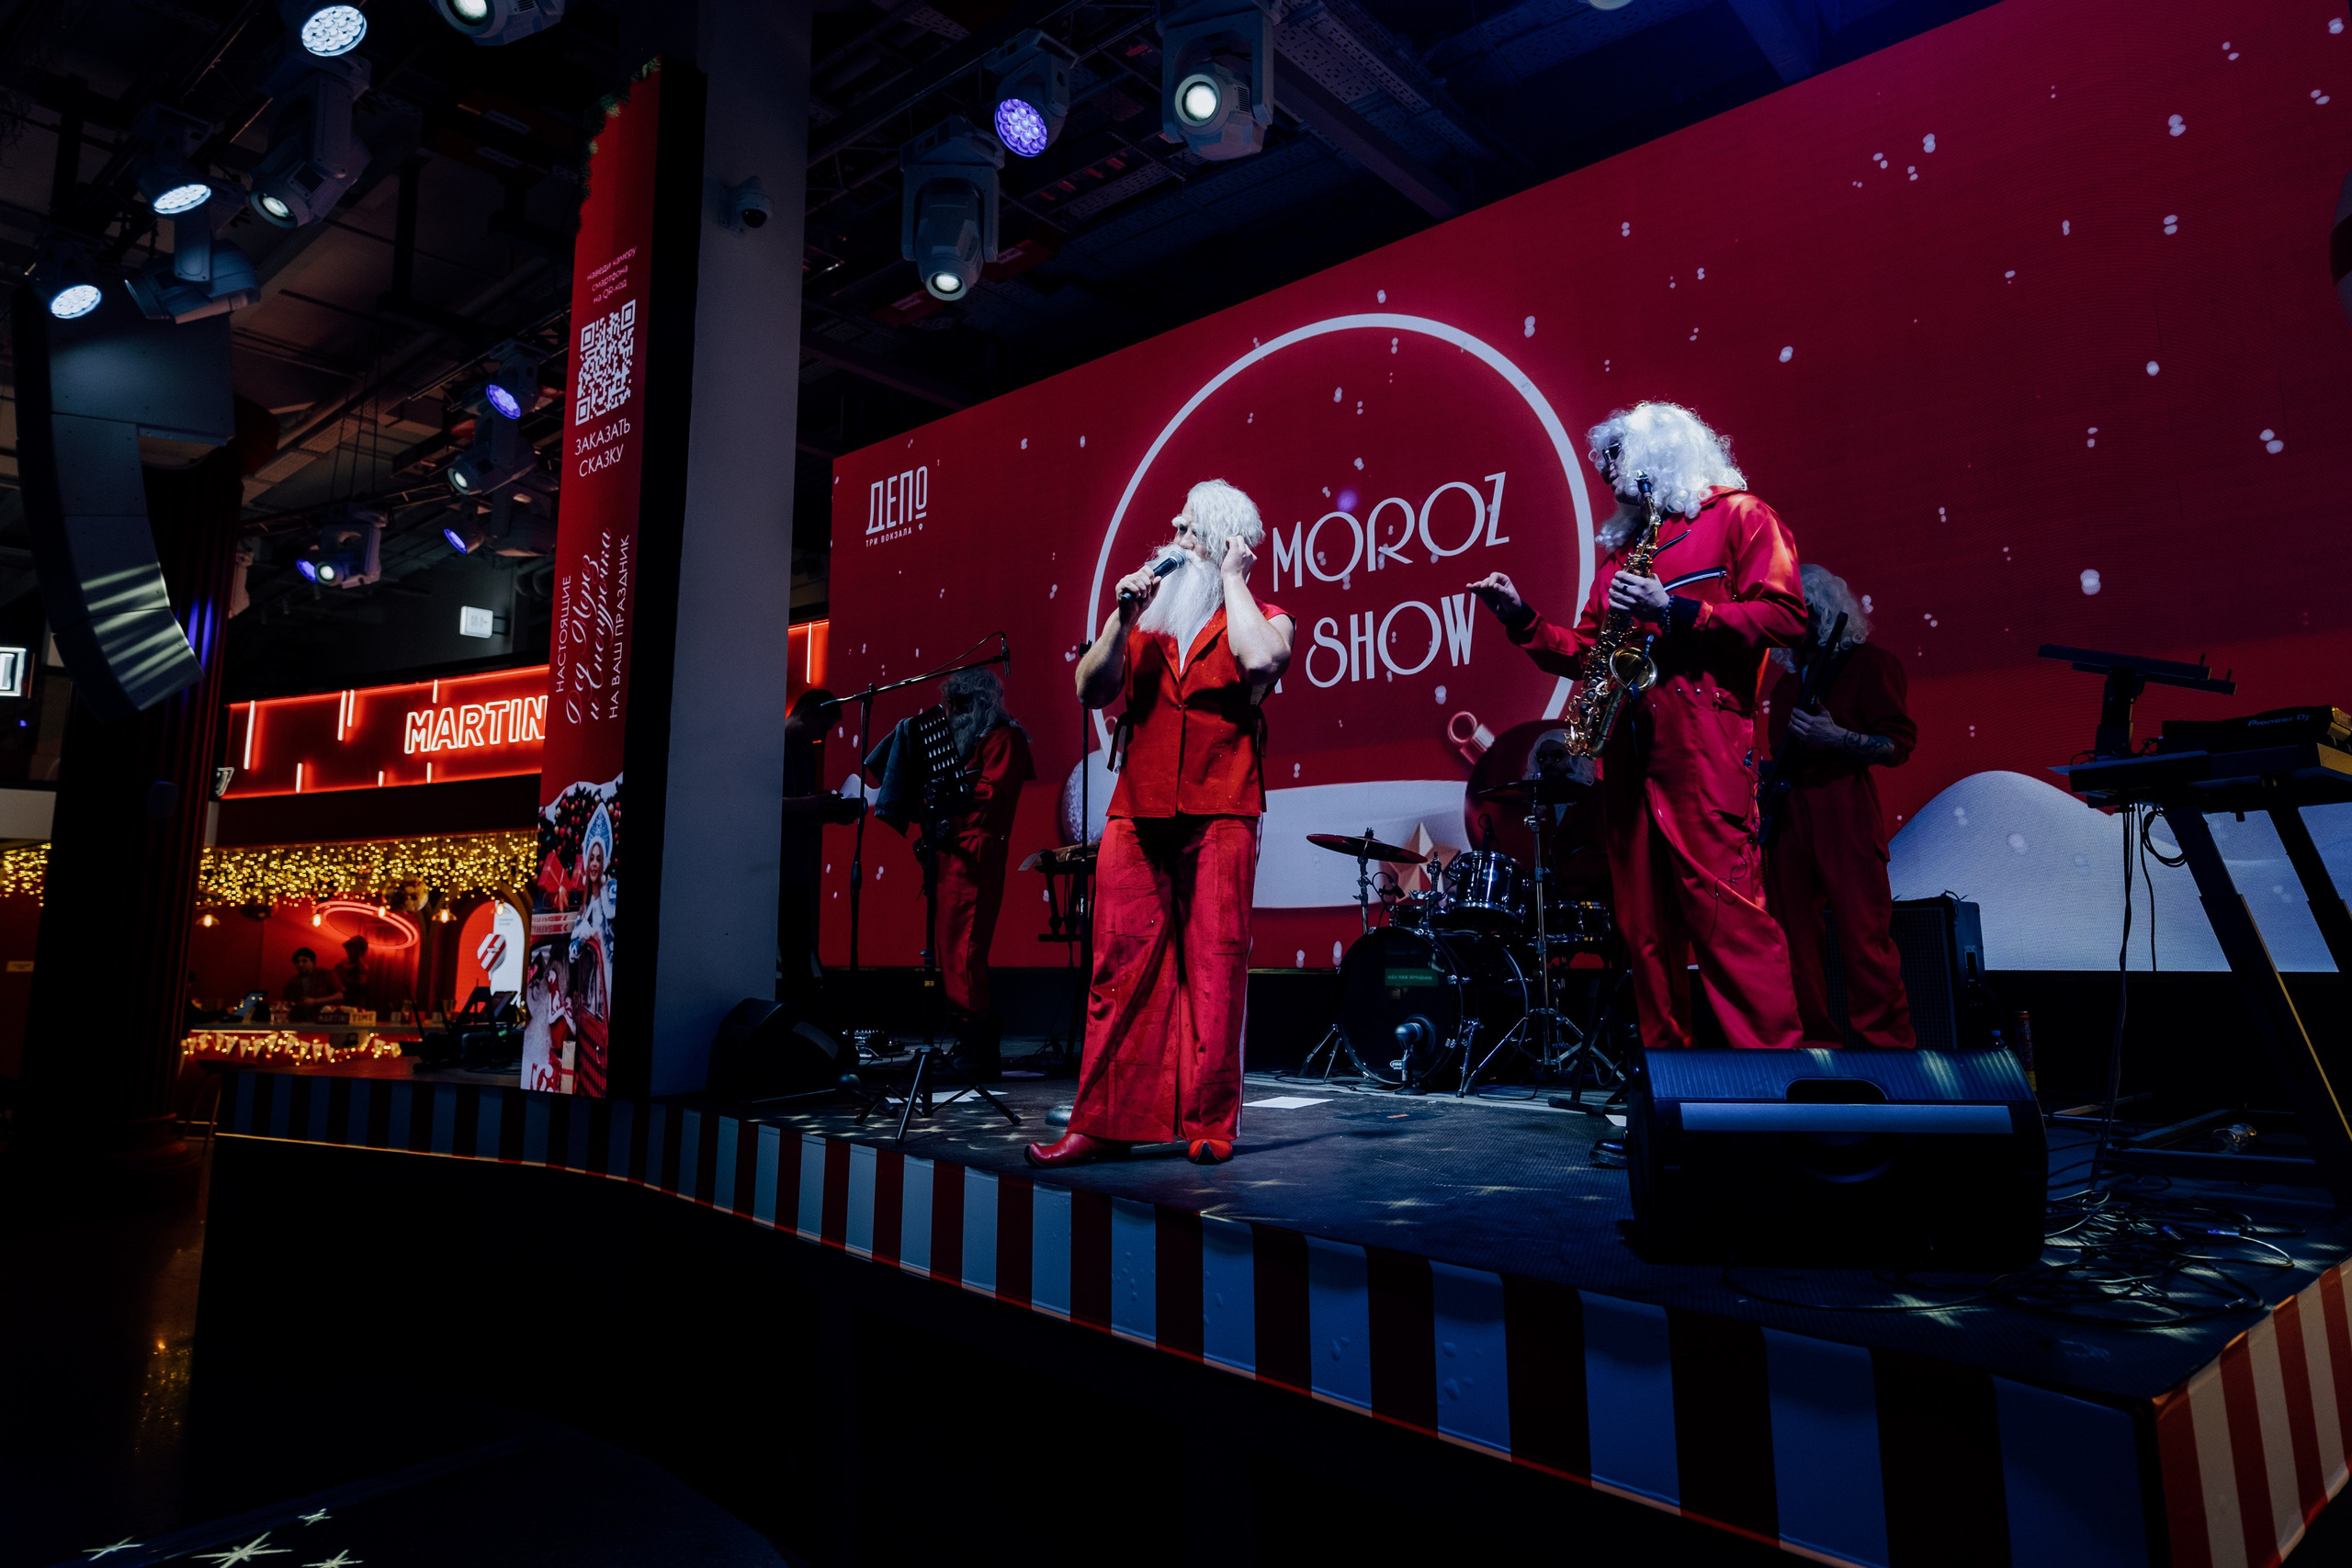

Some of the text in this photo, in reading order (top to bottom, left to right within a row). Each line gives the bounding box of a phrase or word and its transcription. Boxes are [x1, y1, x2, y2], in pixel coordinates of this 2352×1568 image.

[587, 246, 637, 281] наведи камеру
[592, 265, 628, 292] смартфона
[594, 279, 628, 304] на QR-код
[575, 418, 631, 456] ЗАКАЗАТЬ
[579, 444, 624, 478] СКАЗКУ
[865, 466, 928, 535] ДЕПО
[865, 526, 912, 547] ТРИ ВОКЗАЛА
[1272, 471, 1510, 592] MOROZ
[556, 575, 571, 693] НАСТОЯЩИЕ
[566, 554, 599, 726] Дед Мороз
[609, 534, 630, 719] НА ВАШ ПРАЗДНИК
[1306, 592, 1476, 688] SHOW
[2247, 716, 2293, 727] Pioneer
